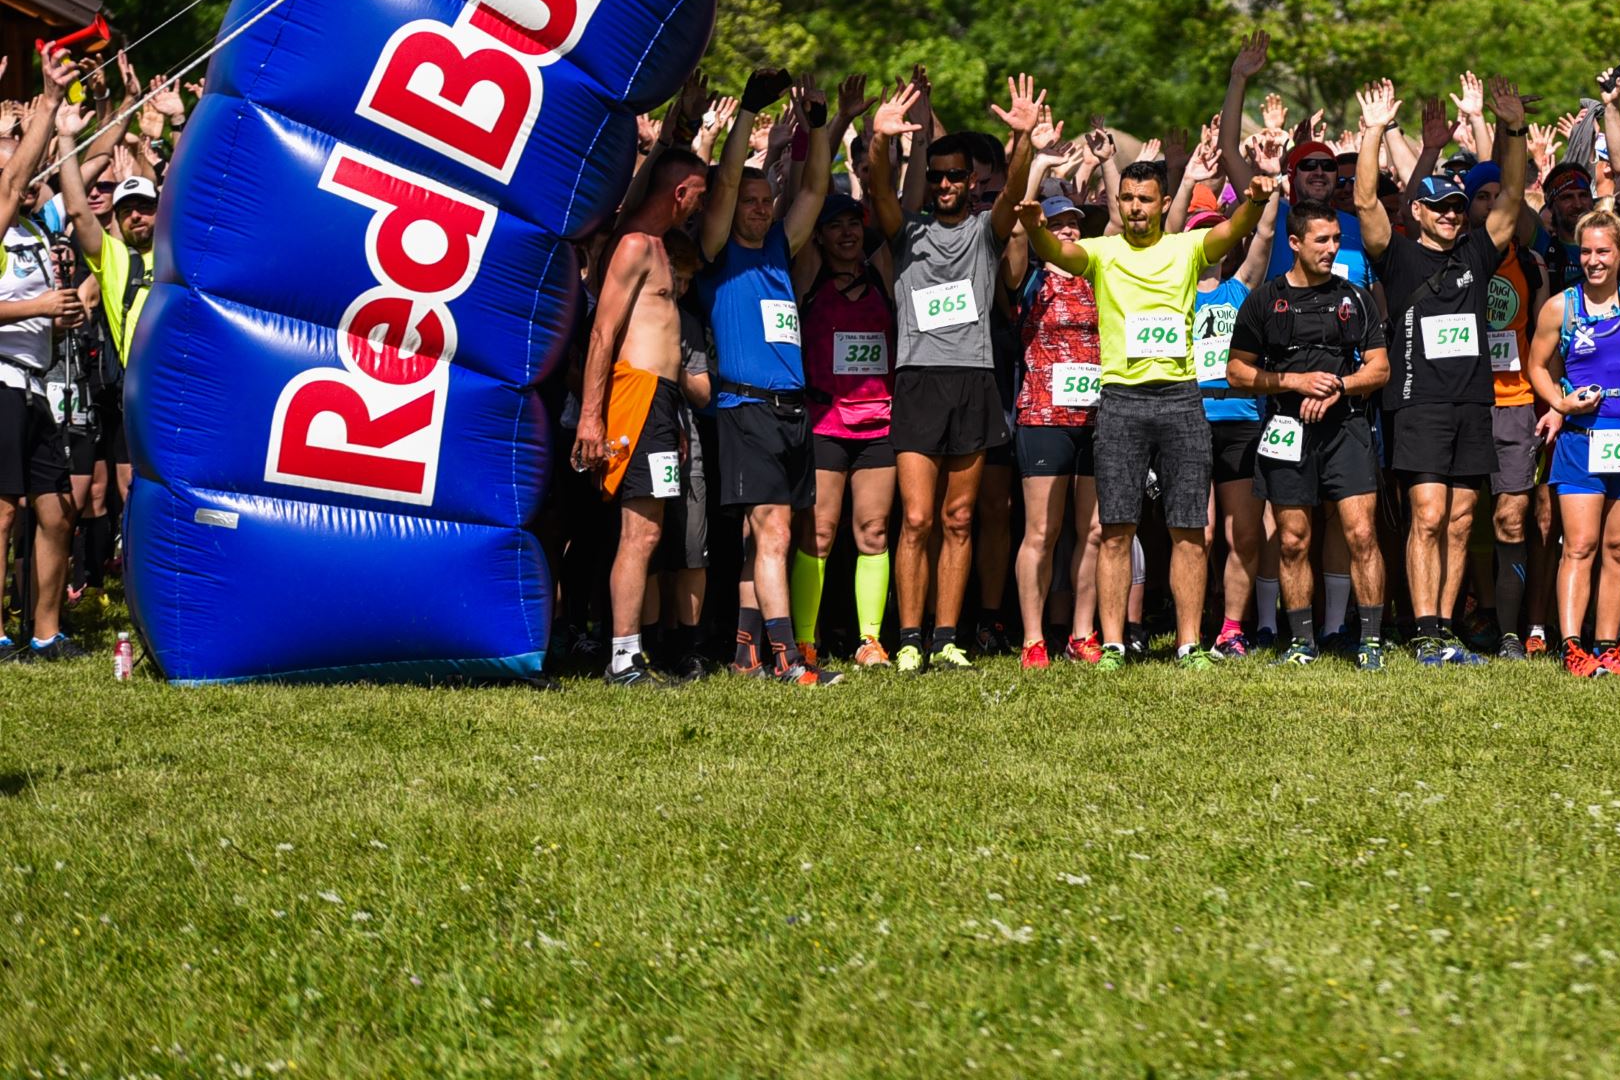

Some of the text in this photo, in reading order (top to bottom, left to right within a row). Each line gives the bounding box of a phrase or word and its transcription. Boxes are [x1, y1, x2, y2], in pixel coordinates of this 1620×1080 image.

[1490, 281, 1511, 297] DUGI
[928, 293, 967, 316] 865
[1487, 295, 1509, 311] OTOK
[274, 154, 489, 497] Red
[775, 312, 798, 332] 343
[1136, 326, 1178, 344] 496
[1437, 326, 1470, 345] 574
[845, 344, 882, 363] 328
[1063, 375, 1101, 394] 584
